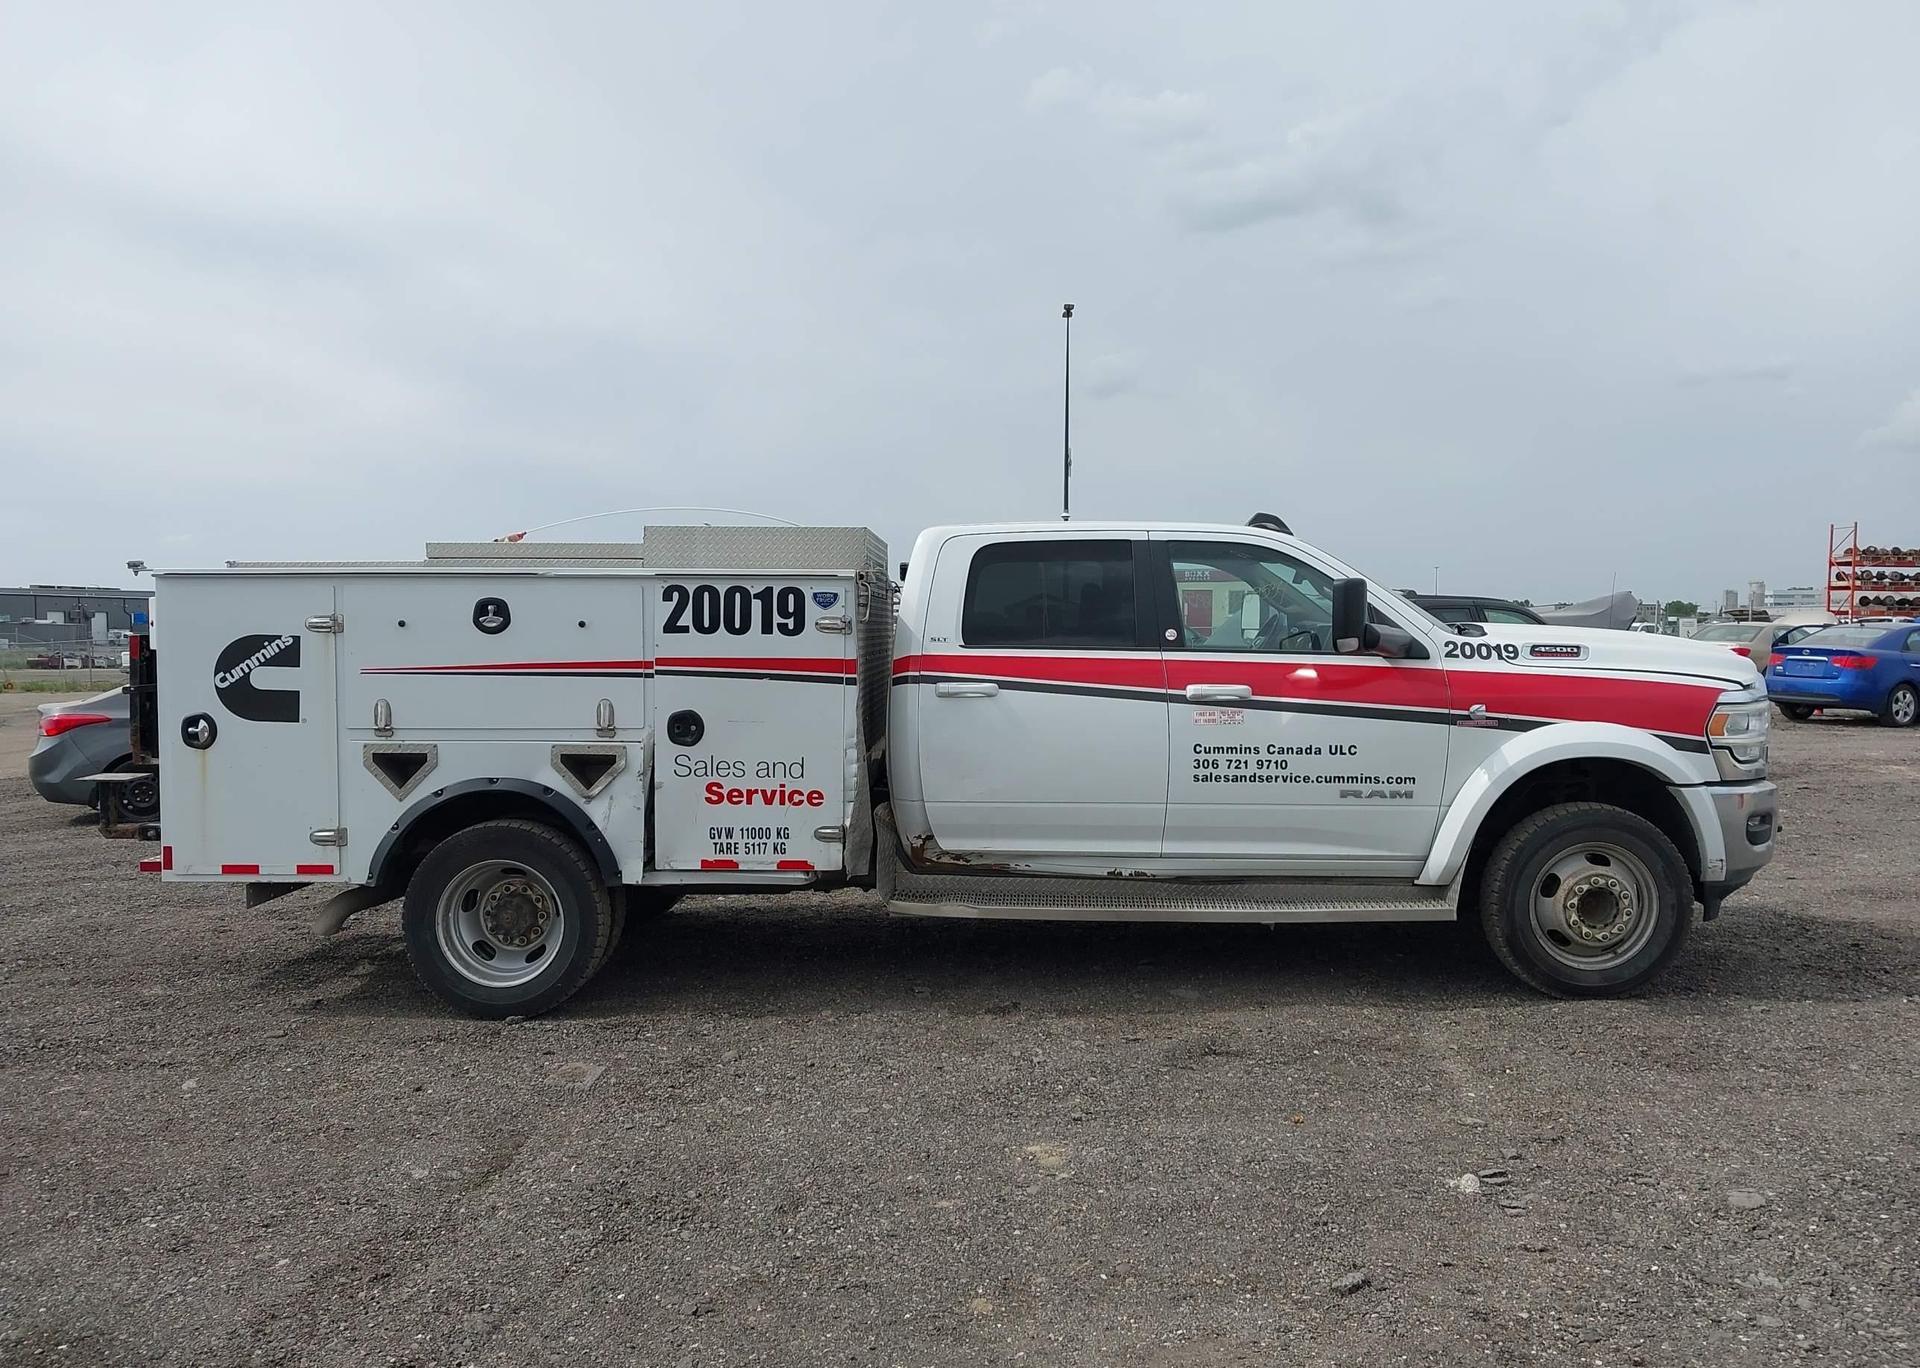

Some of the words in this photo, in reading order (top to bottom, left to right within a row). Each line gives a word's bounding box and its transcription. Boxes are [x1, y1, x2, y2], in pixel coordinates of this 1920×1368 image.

[662, 584, 806, 637] 20019
[1443, 640, 1520, 660] 20019
[214, 634, 294, 688] Cummins
[1192, 743, 1261, 755] Cummins
[1266, 744, 1322, 756] Canada
[1328, 745, 1358, 756] ULC
[673, 754, 746, 778] Sales
[755, 756, 805, 779] and
[1192, 759, 1220, 770] 306
[1226, 759, 1249, 770] 721
[1256, 759, 1288, 770] 9710
[1192, 772, 1416, 785] salesandservice.cummins.com
[704, 781, 825, 807] Service
[1339, 789, 1414, 799] RAM
[709, 826, 735, 840] GVW
[739, 827, 772, 840] 11000
[776, 827, 790, 840] KG
[713, 842, 739, 855] TARE
[744, 842, 768, 855] 5117
[773, 842, 787, 855] KG
